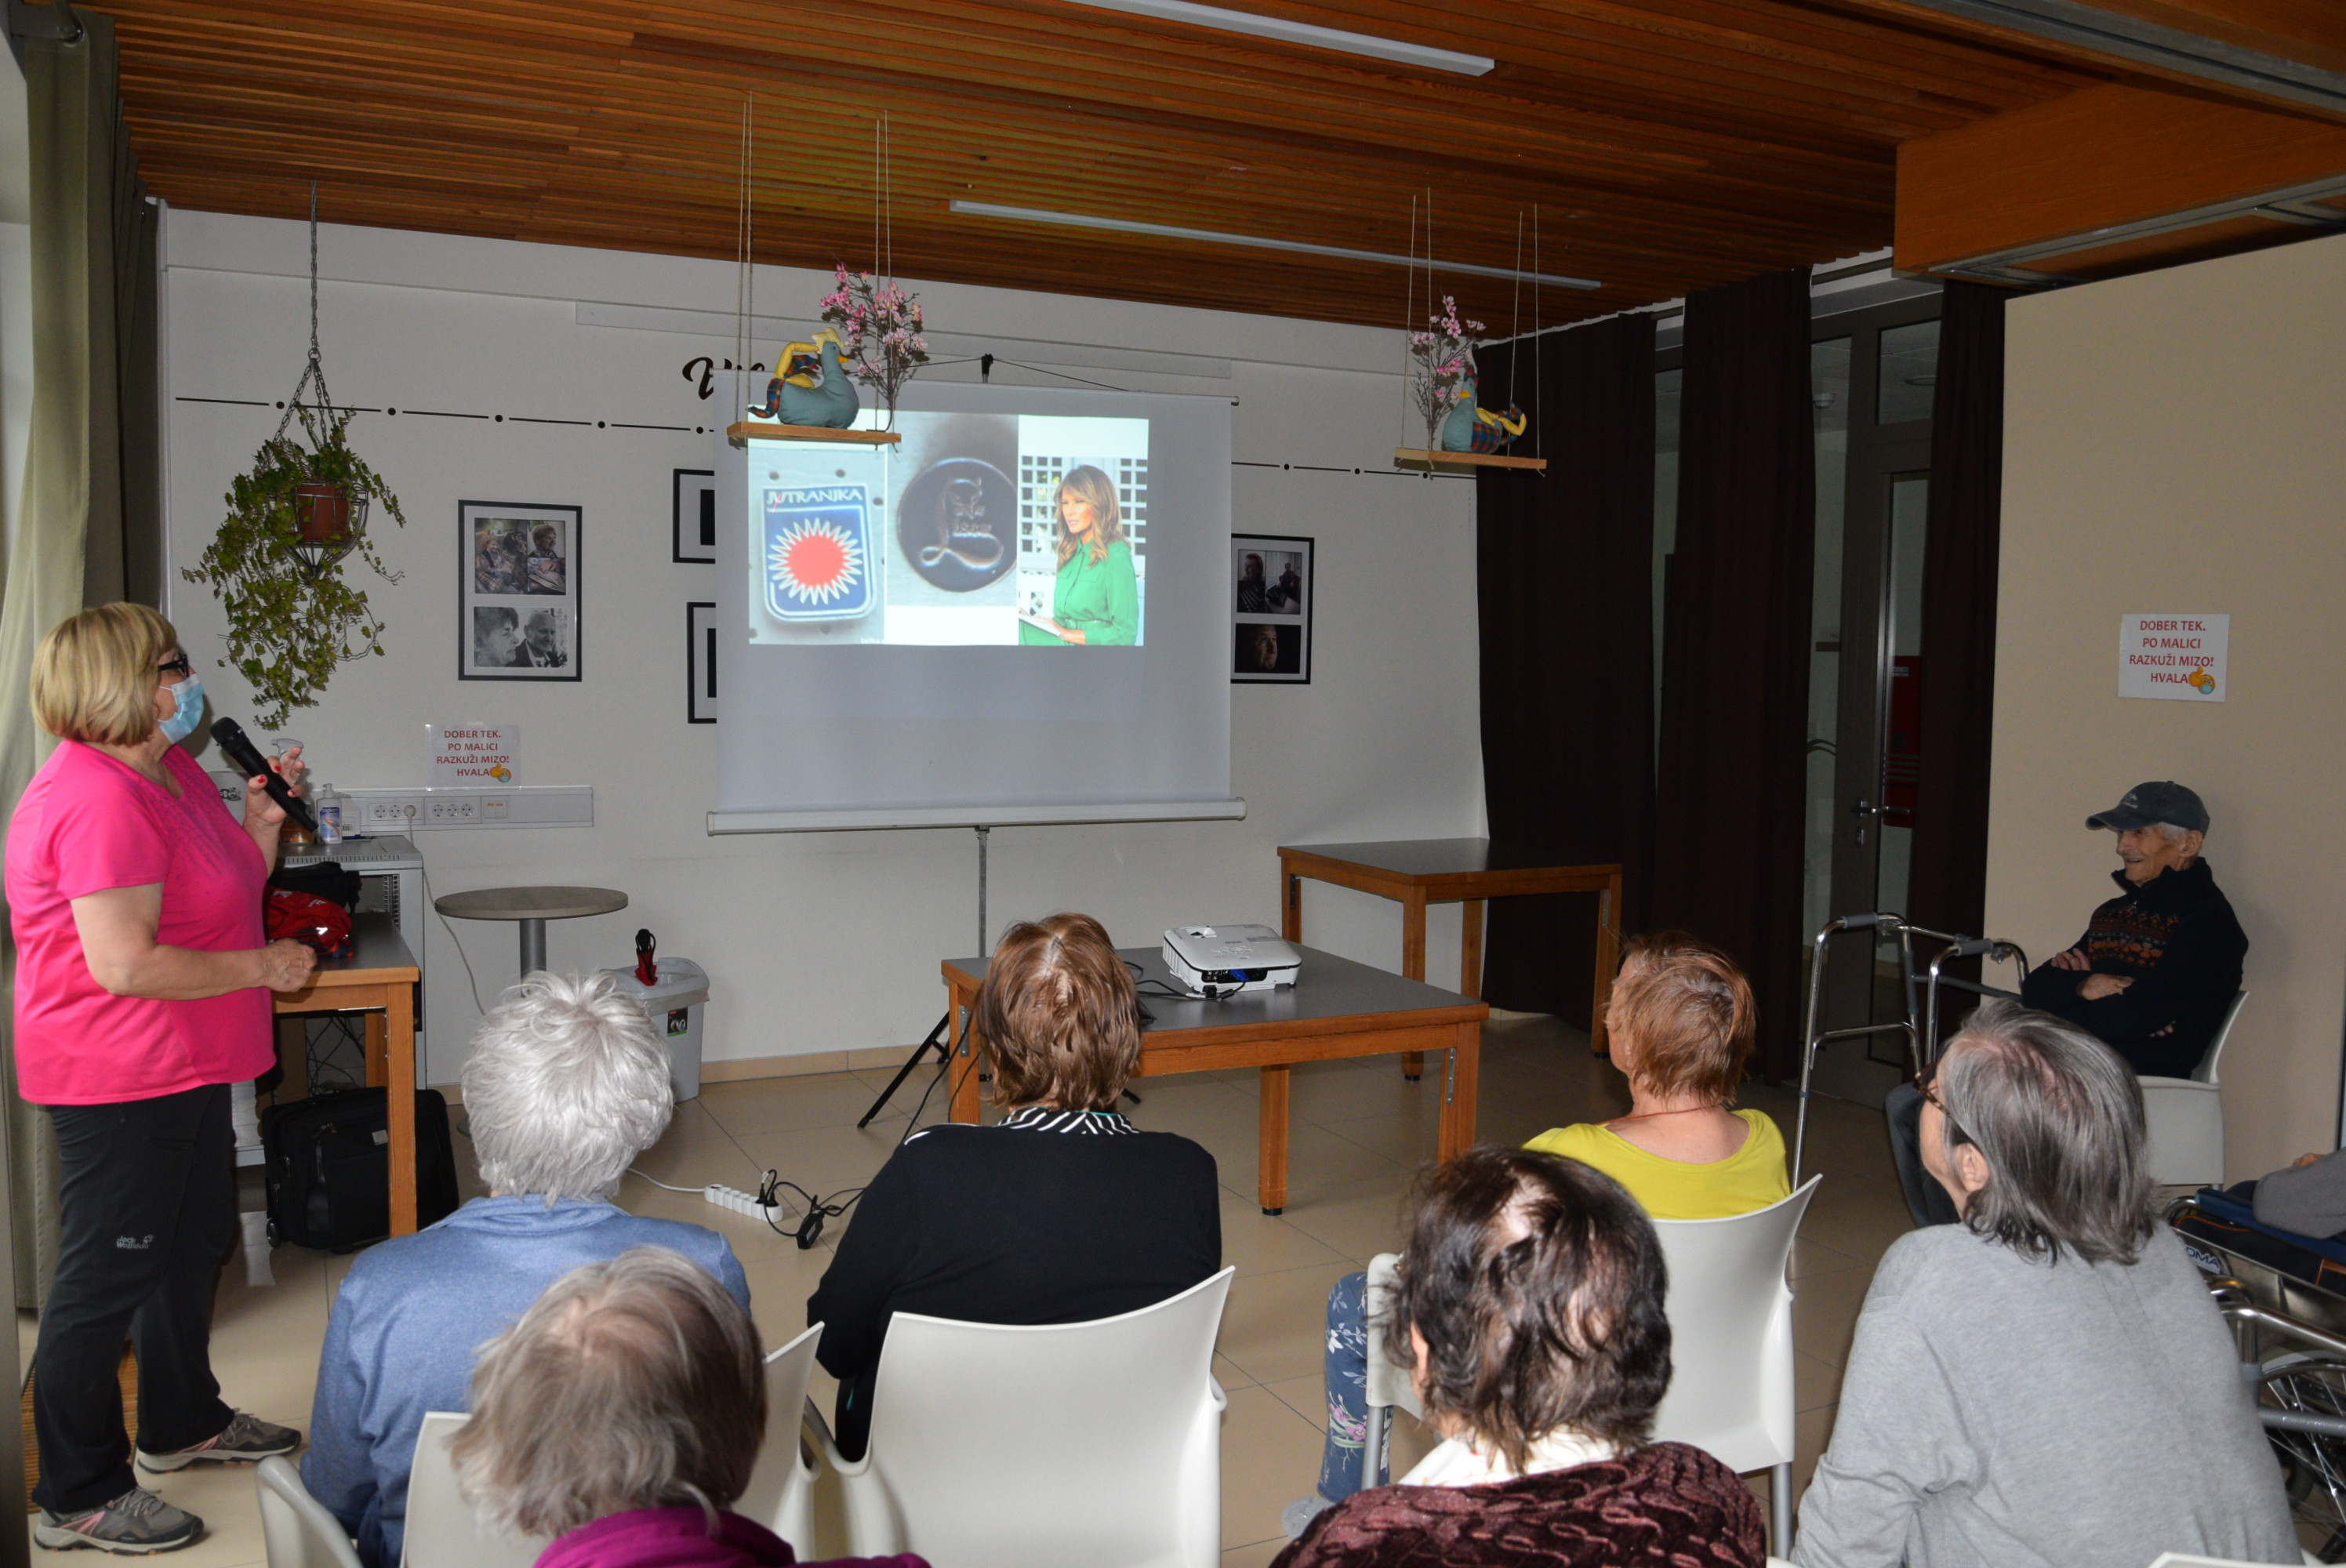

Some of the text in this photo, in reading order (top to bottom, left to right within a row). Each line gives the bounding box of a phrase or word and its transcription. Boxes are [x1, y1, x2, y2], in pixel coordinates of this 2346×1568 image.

[767, 488, 862, 505] JUTRANJKA
[2140, 620, 2206, 631] DOBER TEK.
[2142, 637, 2201, 649] PO MALICI
[2129, 653, 2214, 667] RAZKUŽI MIZO!
[2150, 673, 2188, 684] HVALA
[444, 730, 502, 739] DOBER TEK.
[448, 742, 498, 751] PO MALICI
[436, 754, 510, 764] RAZKUŽI MIZO!
[116, 1235, 136, 1243] Jack
